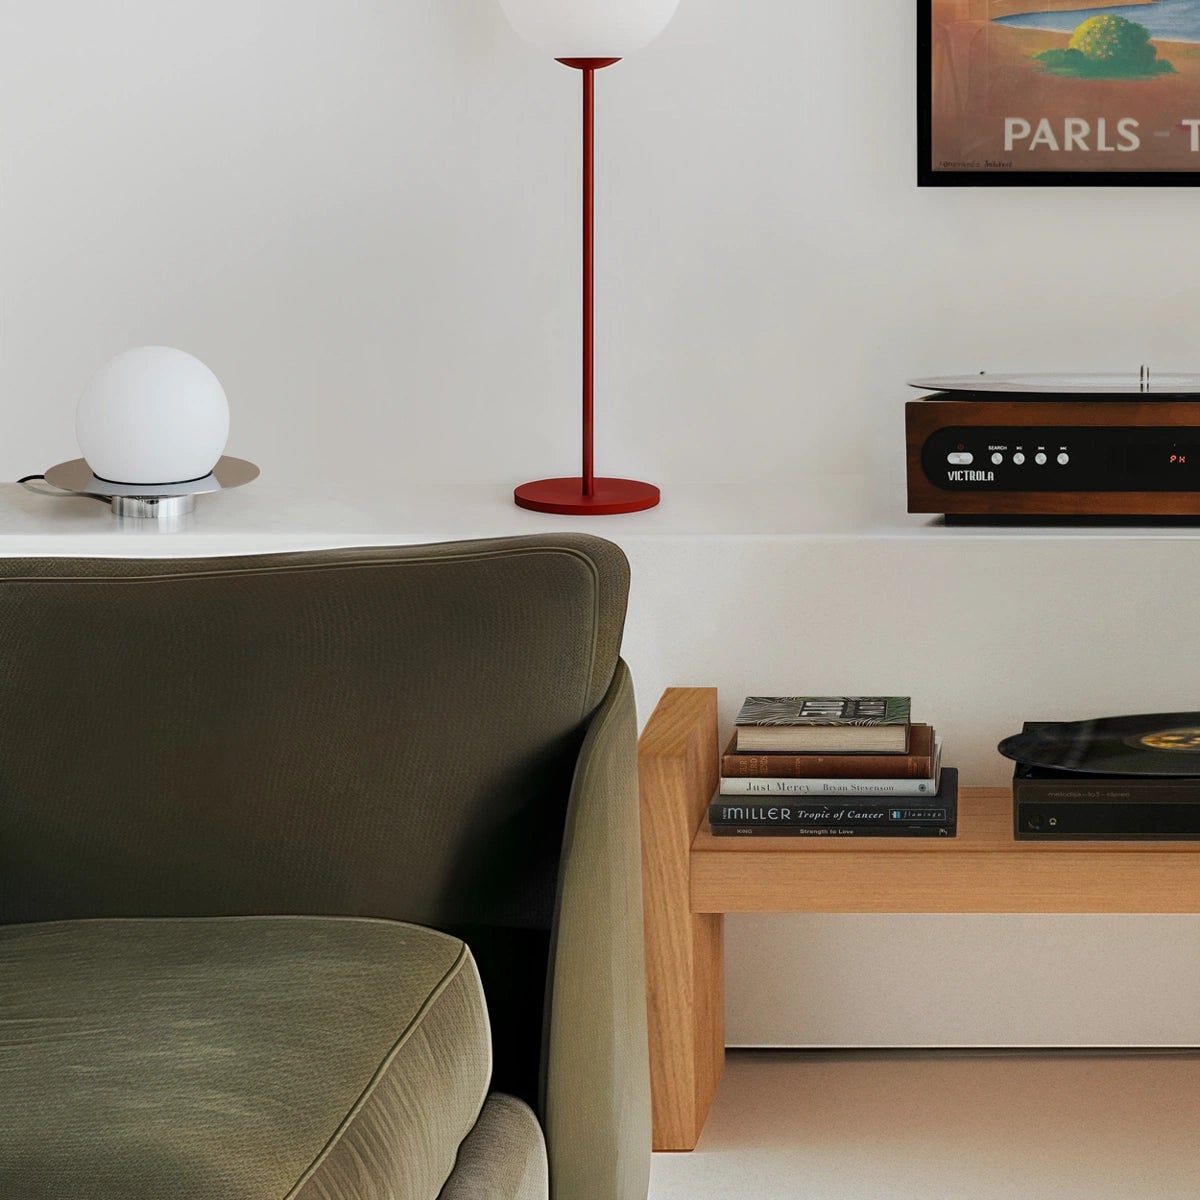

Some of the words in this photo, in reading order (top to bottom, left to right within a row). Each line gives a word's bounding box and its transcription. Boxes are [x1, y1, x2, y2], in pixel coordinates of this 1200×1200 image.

[947, 470, 995, 482] VICTROLA
[746, 782, 771, 792] Just
[776, 782, 811, 795] Mercy
[822, 783, 849, 794] Bryan
[851, 783, 895, 793] Stevenson
[727, 807, 792, 821] MILLER
[797, 809, 830, 821] Tropic
[833, 809, 846, 821] of
[847, 809, 885, 820] Cancer
